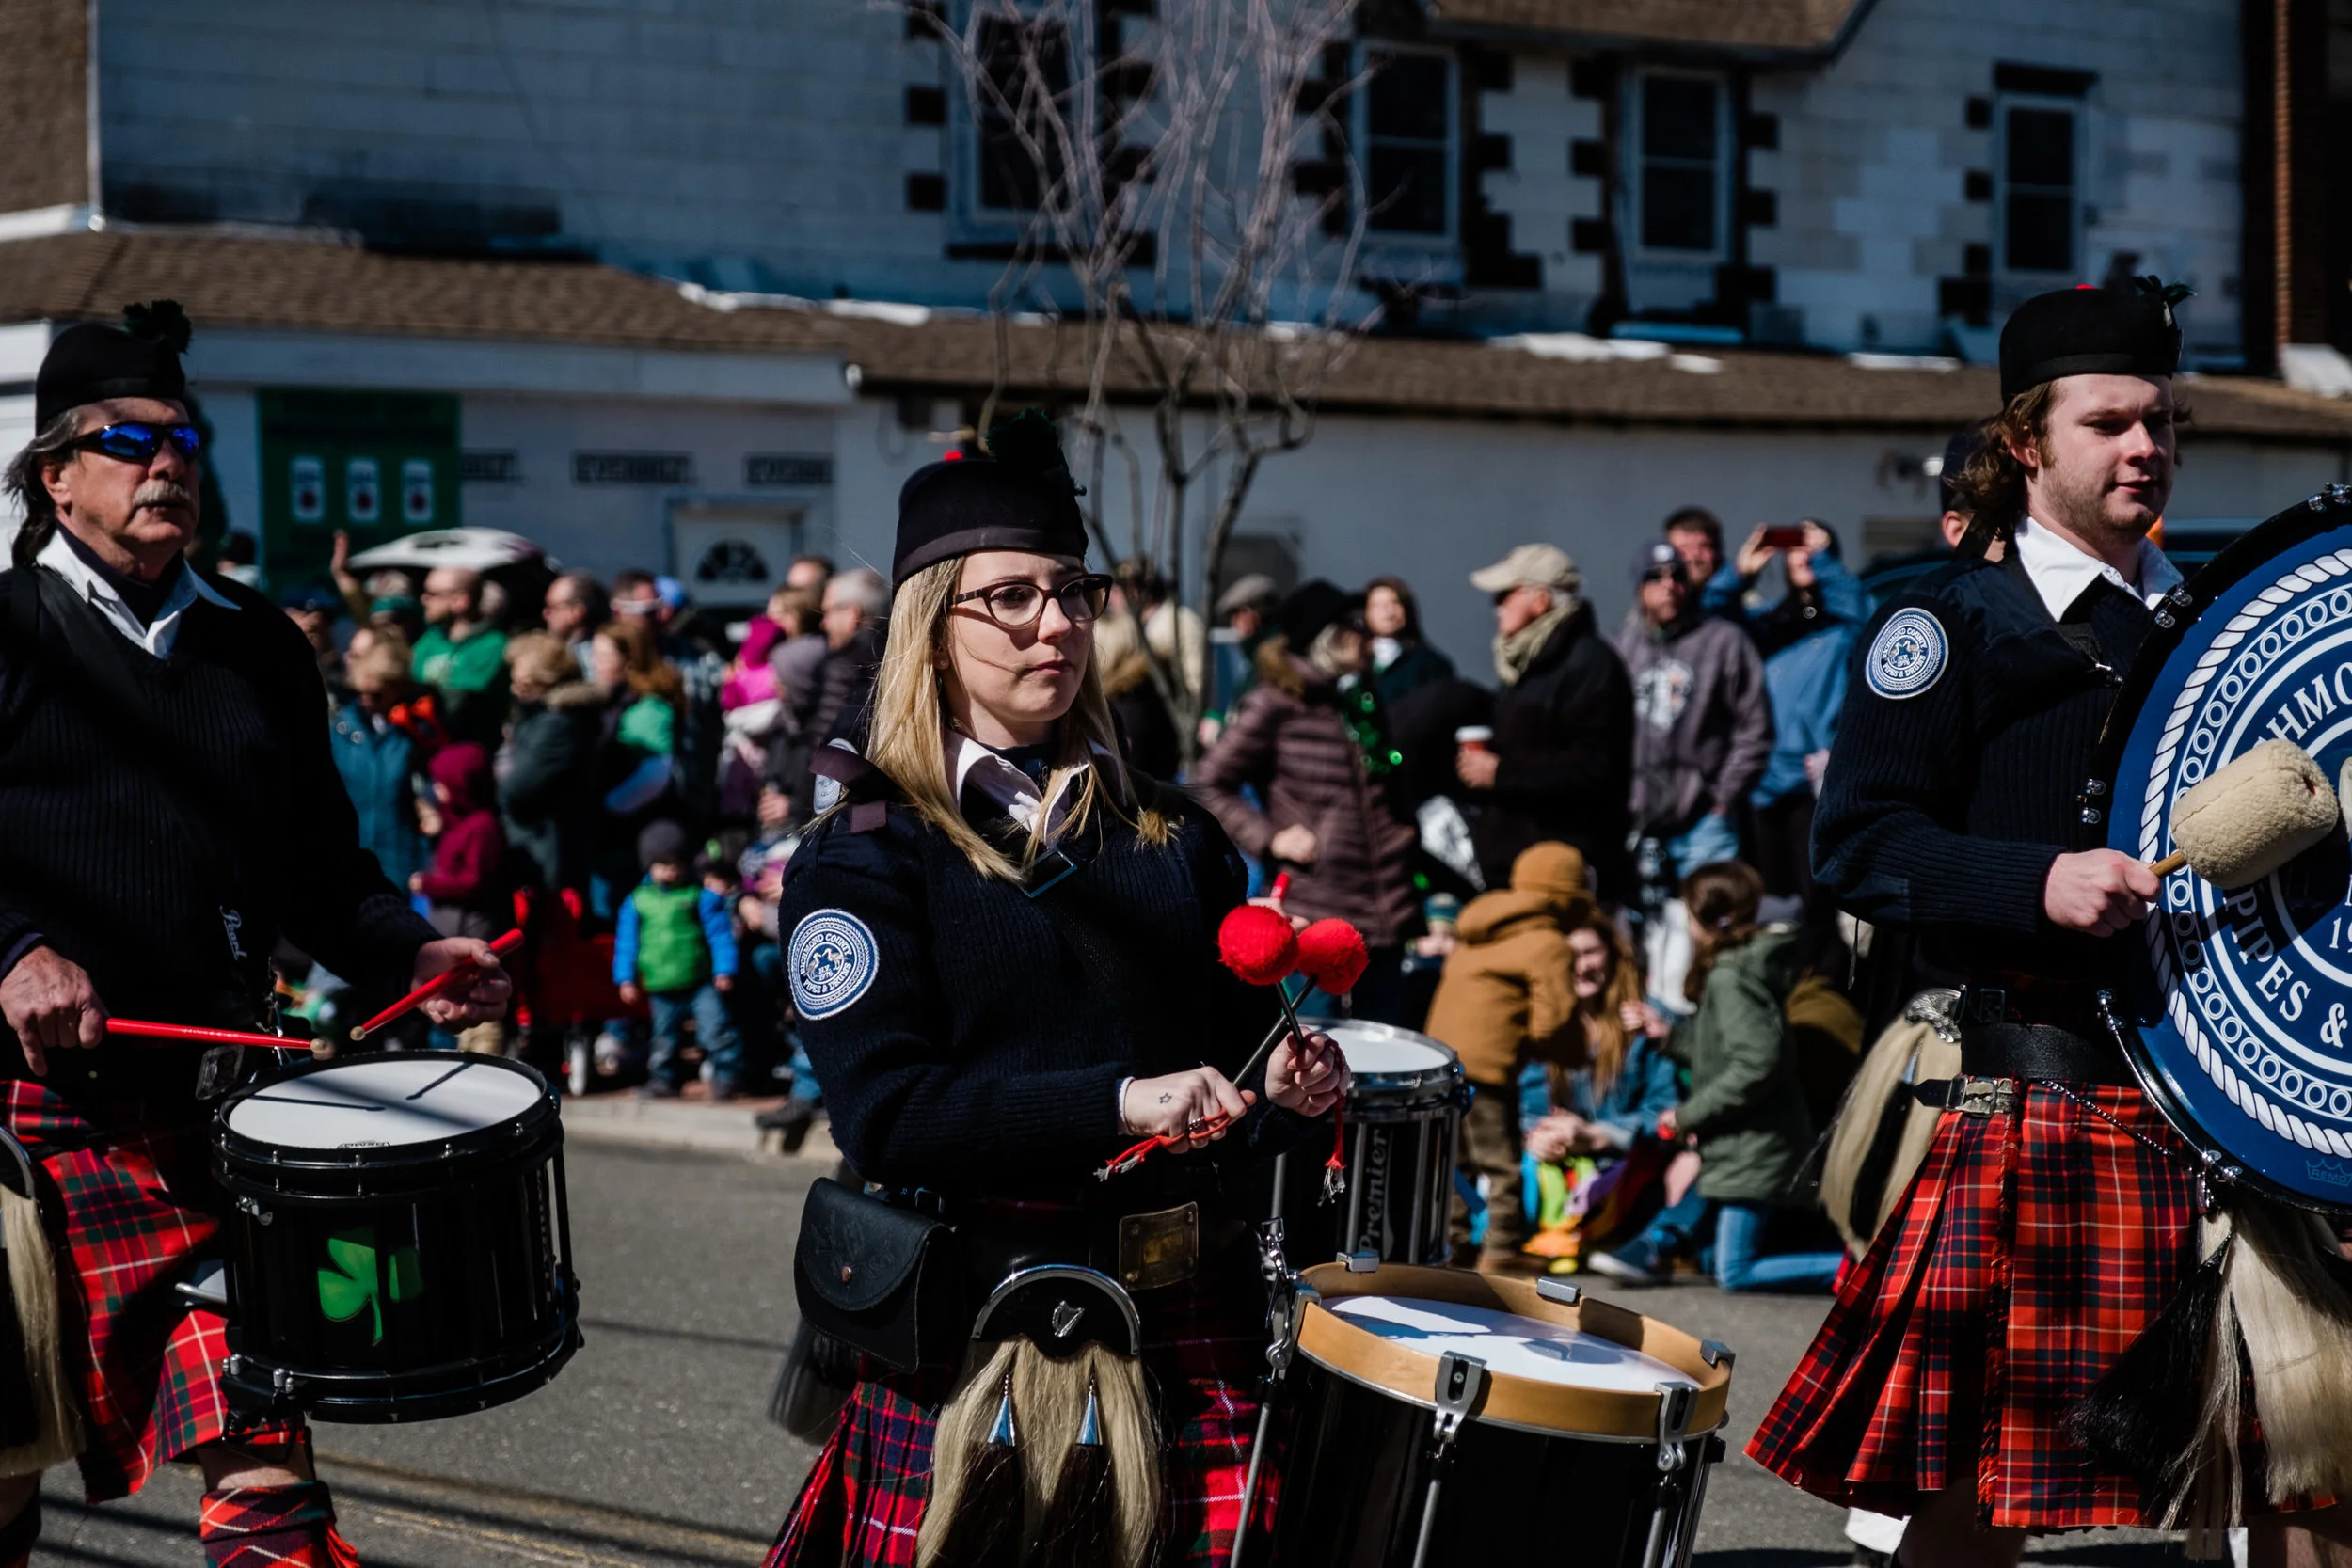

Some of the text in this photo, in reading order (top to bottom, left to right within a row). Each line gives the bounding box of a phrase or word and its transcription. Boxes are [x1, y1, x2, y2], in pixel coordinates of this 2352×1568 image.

[1907, 627, 1928, 649] COUNTY
[1905, 655, 1927, 677] DRUMS
[2252, 662, 2352, 749] HMO
[219, 905, 248, 959] Pearl
[800, 932, 853, 974] RICHMOND COUNTY
[803, 962, 851, 994] PIPES & DRUMS
[2223, 887, 2348, 1049] PIPES &
[1358, 1129, 1388, 1256] Premier
[2312, 1169, 2347, 1183] REMO
